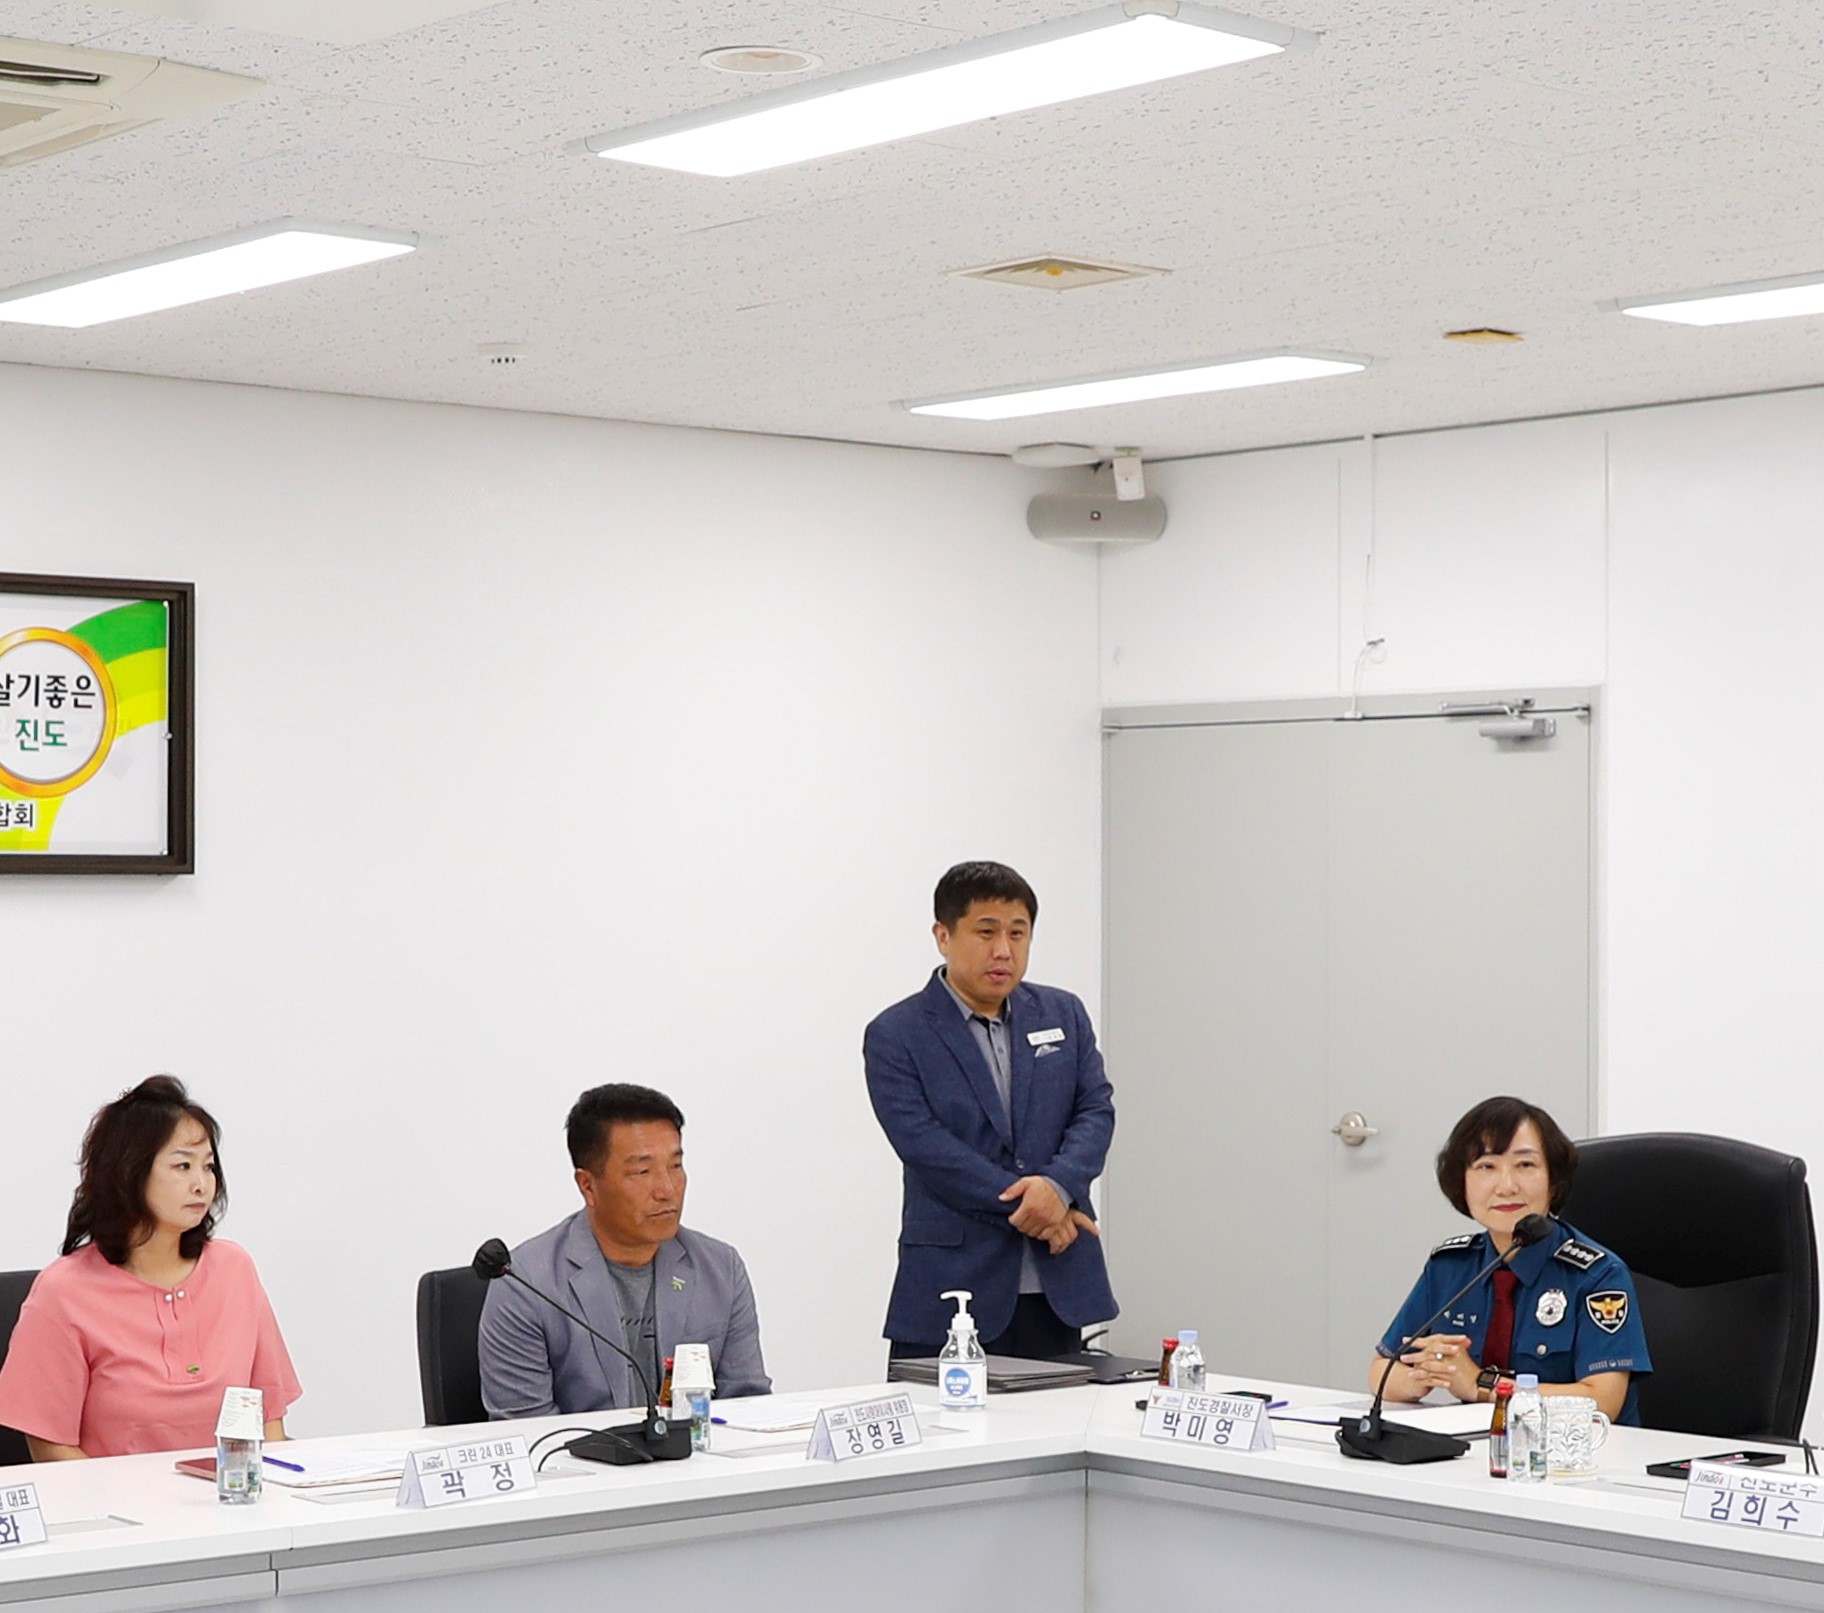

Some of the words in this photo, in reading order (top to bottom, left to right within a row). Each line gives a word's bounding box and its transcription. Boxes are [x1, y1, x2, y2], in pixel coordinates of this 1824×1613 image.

[13, 719, 69, 753] 진도
[1186, 1396, 1254, 1418] 진도경찰서장
[846, 1418, 906, 1455] 장영길
[1162, 1411, 1235, 1446] 박미영
[496, 1442, 515, 1457] 대표
[6, 1489, 30, 1507] 대표
[1710, 1490, 1801, 1530] 김희수
